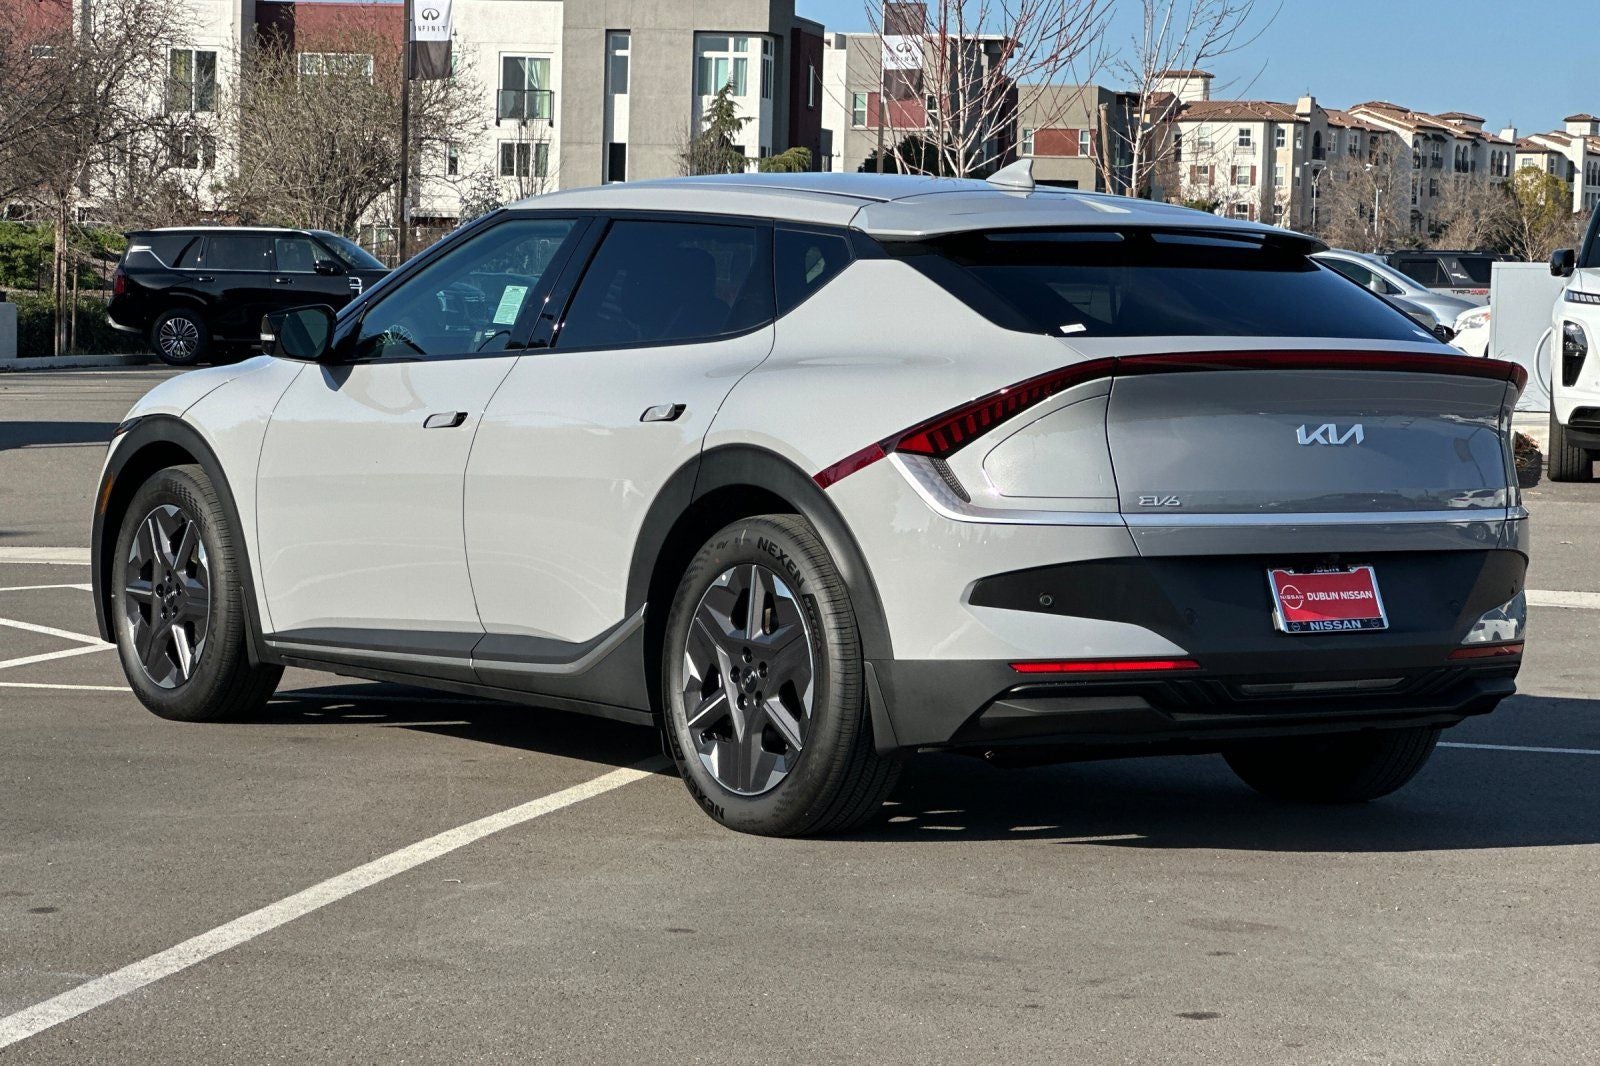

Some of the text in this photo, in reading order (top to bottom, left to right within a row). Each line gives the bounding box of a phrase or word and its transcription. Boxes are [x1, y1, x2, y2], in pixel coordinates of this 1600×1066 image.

[1296, 423, 1364, 444] KIA
[1139, 495, 1180, 506] EV6
[757, 536, 805, 588] NEXEN
[1306, 590, 1373, 601] DUBLIN NISSAN
[1310, 620, 1361, 631] NISSAN
